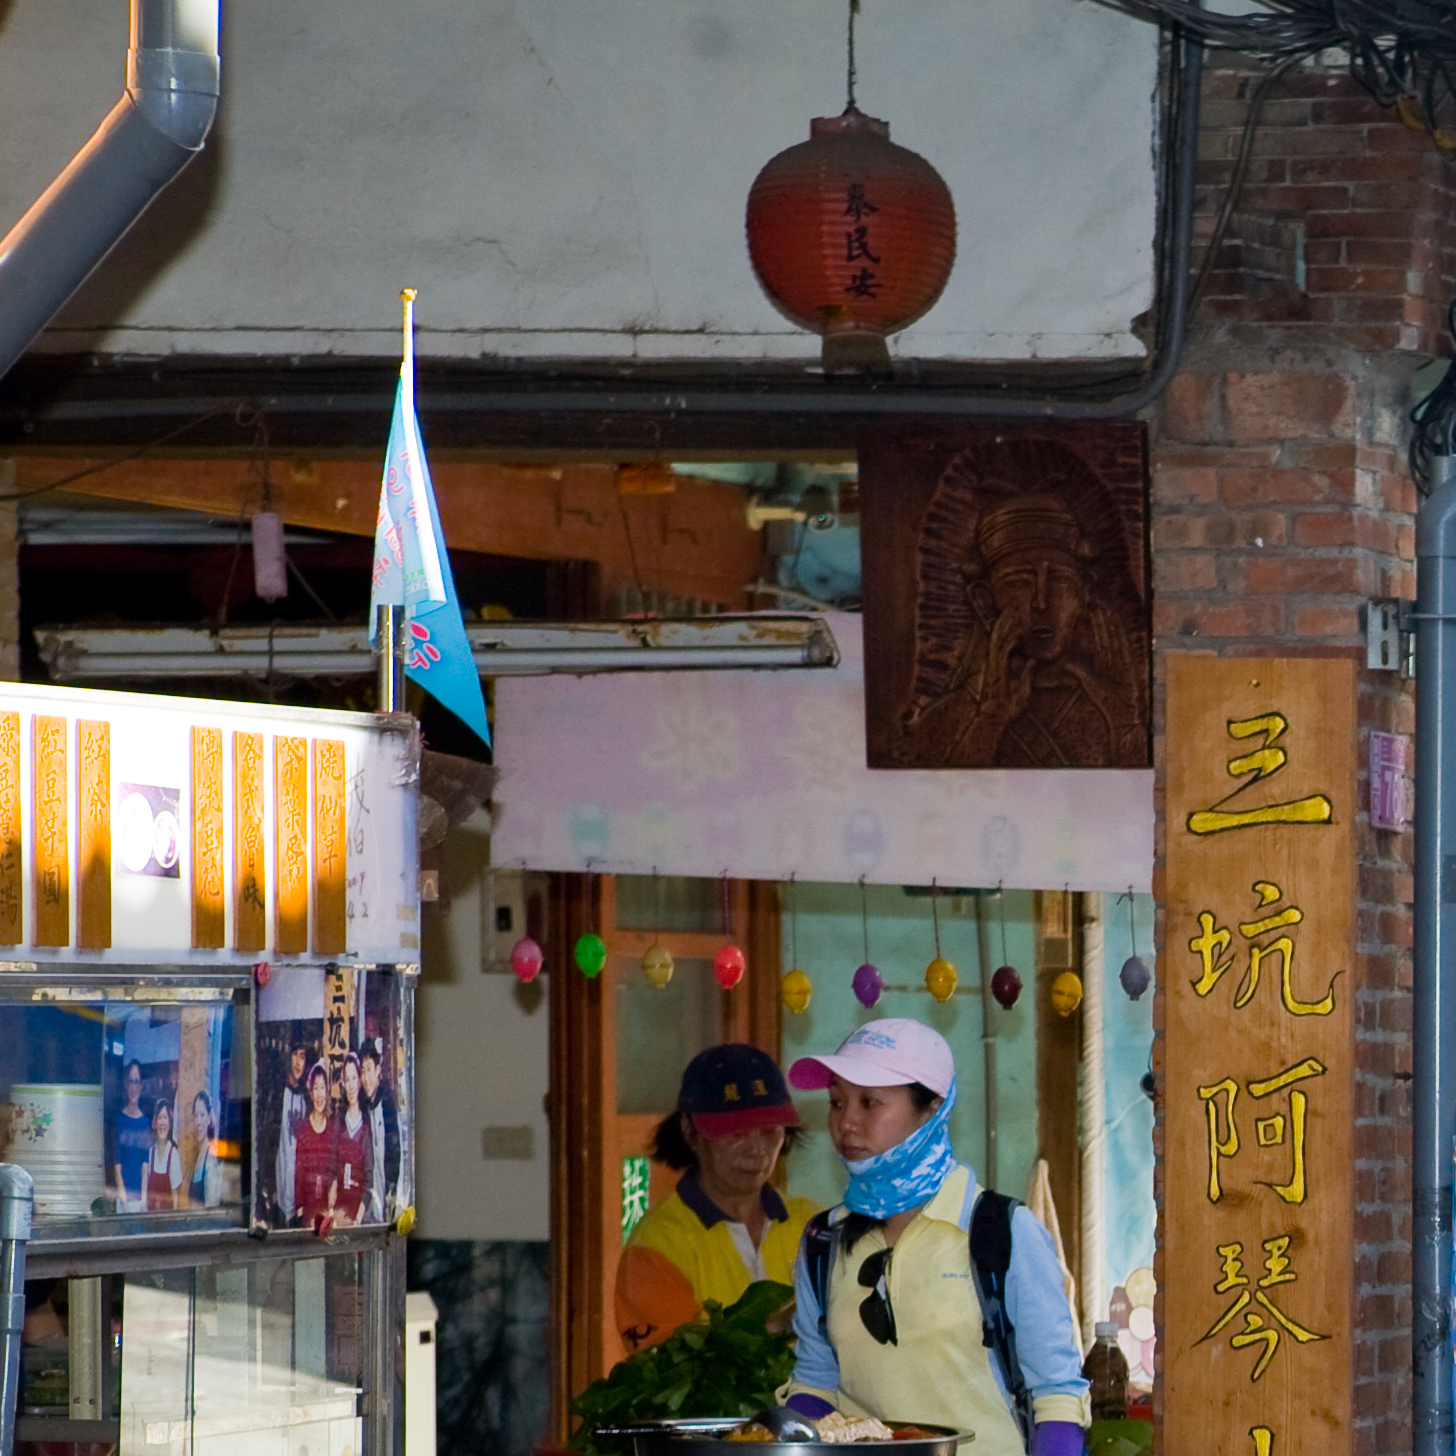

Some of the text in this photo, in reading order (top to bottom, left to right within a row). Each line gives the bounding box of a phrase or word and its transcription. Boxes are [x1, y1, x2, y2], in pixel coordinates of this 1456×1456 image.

[85, 732, 107, 823] 紅茶
[319, 743, 344, 878] 燒仙草
